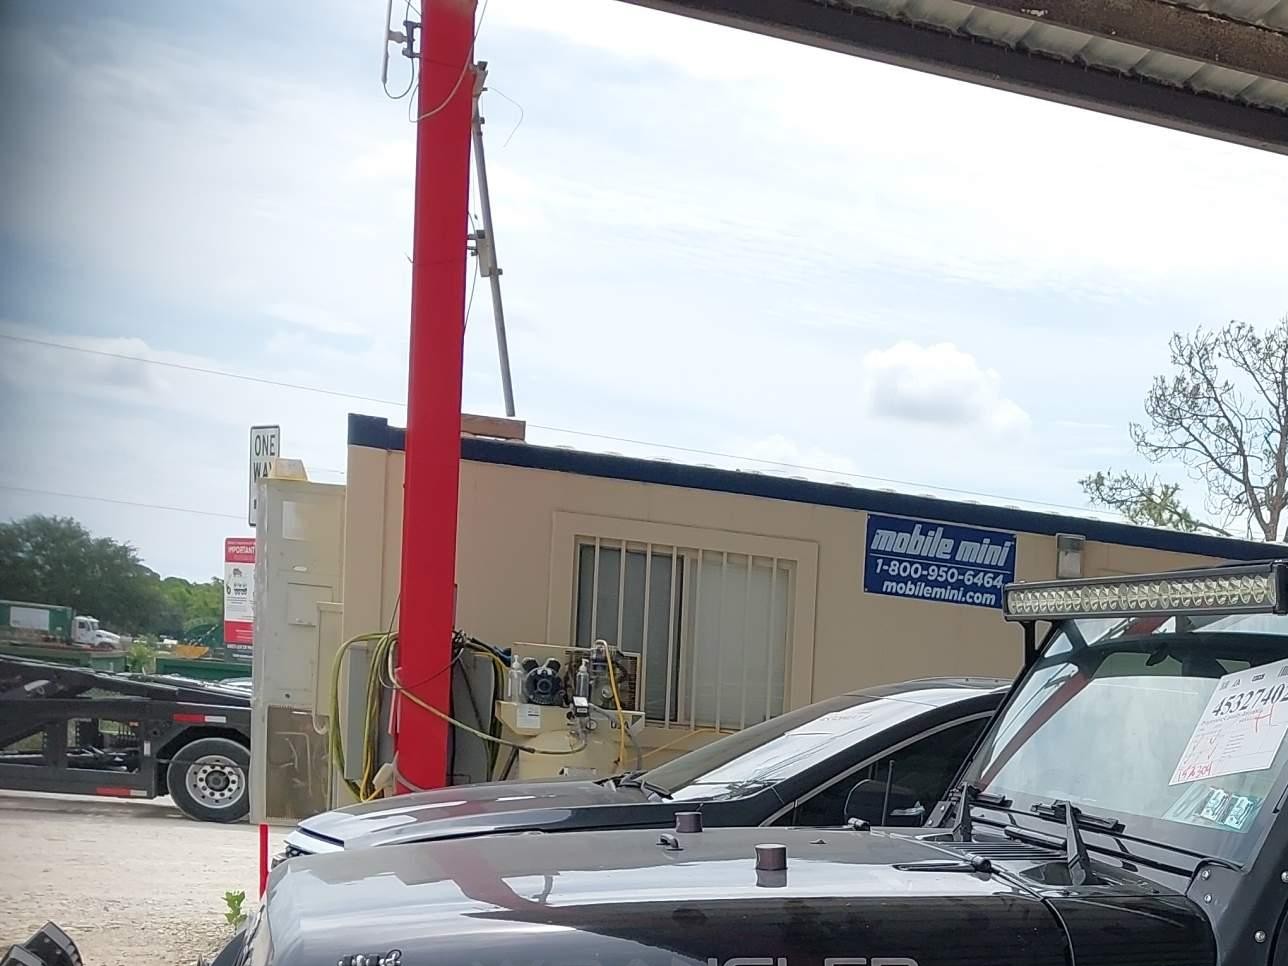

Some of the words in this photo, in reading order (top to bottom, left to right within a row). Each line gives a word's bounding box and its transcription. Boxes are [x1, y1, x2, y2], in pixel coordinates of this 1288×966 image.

[254, 434, 276, 457] ONE
[253, 461, 272, 483] WA
[870, 524, 954, 559] mobile
[955, 538, 1012, 567] mini
[876, 558, 1004, 588] 1-800-950-6464
[882, 579, 997, 606] mobilemini.com
[611, 719, 631, 729] UA
